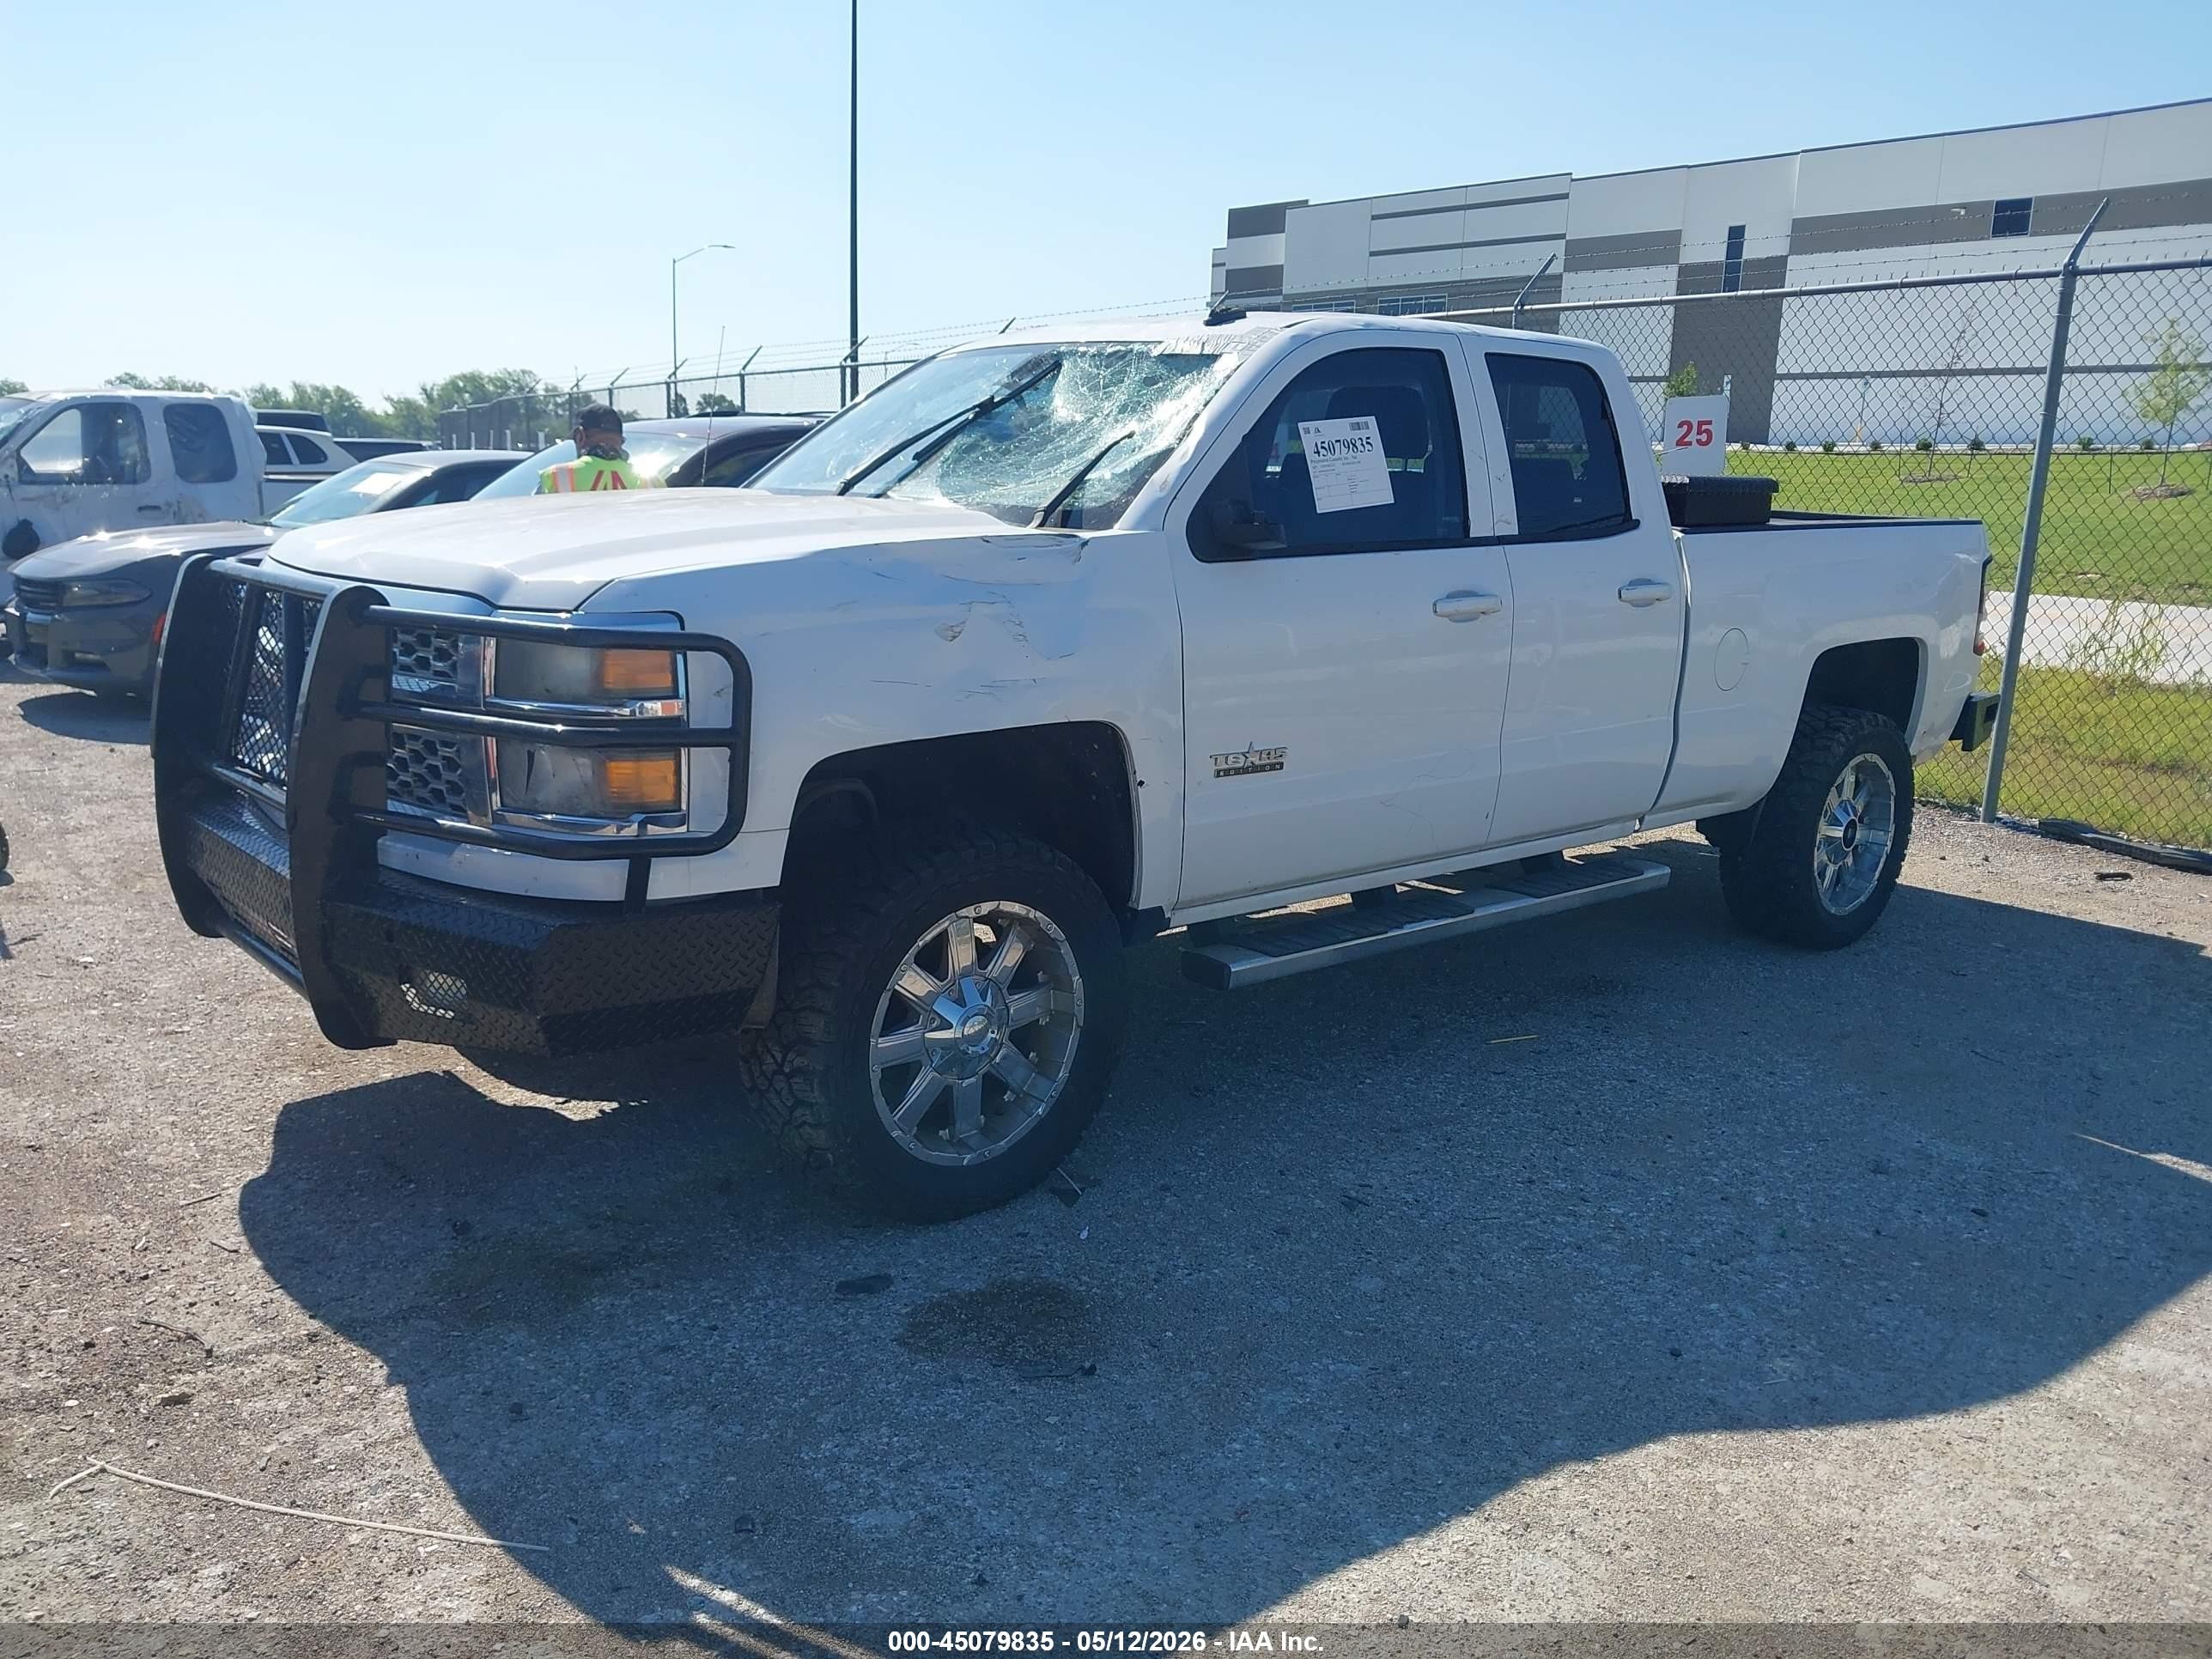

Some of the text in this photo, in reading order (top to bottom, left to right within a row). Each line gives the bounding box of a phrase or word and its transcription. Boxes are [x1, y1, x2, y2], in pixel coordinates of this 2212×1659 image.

[1675, 419, 1713, 447] 25
[1313, 435, 1374, 458] 45079835
[1218, 763, 1281, 776] EDITION
